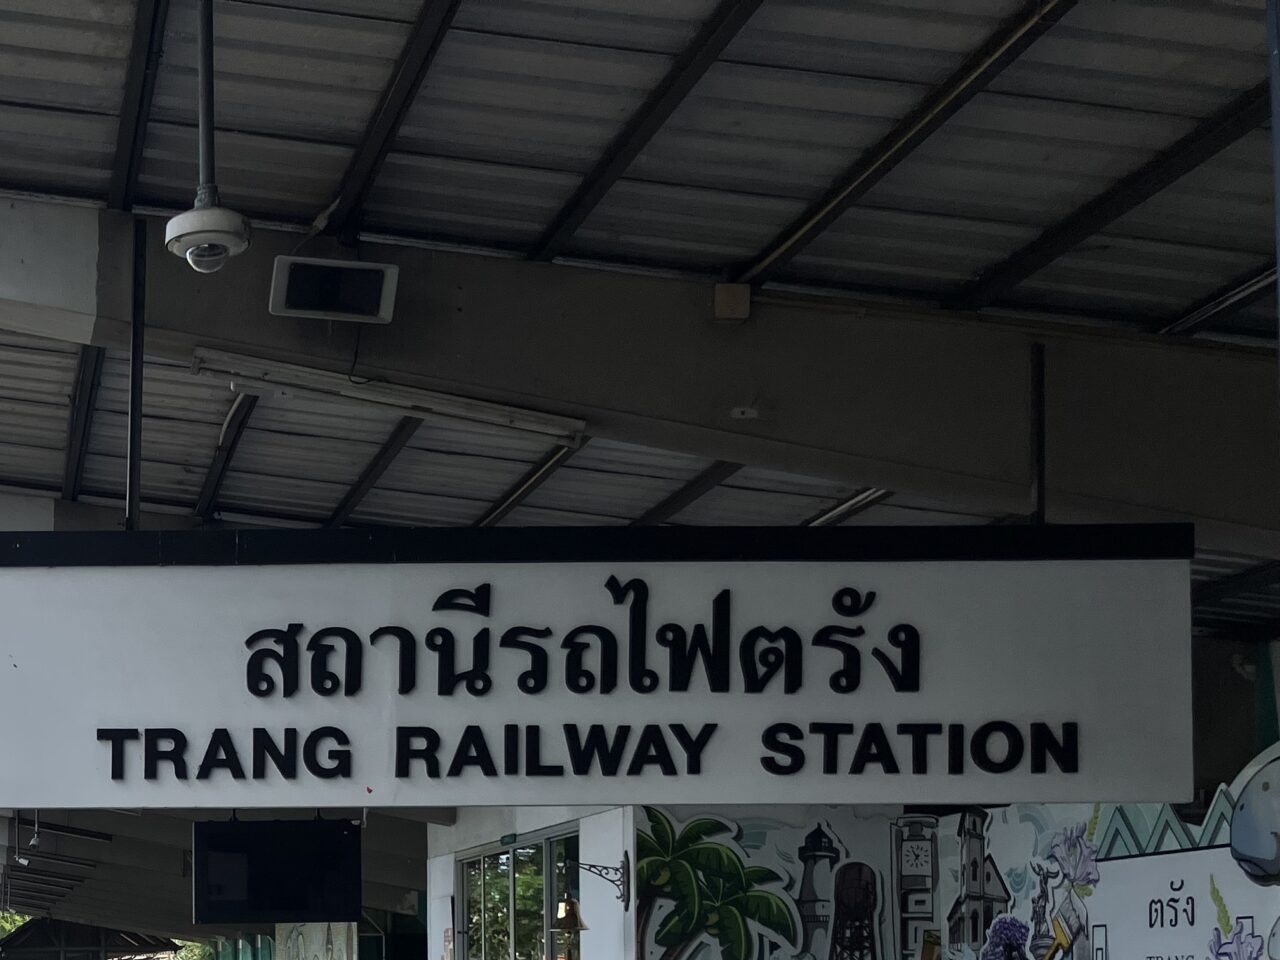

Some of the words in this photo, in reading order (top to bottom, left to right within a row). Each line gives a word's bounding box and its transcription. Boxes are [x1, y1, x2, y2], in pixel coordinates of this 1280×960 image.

[245, 574, 921, 699] สถานีรถไฟตรัง
[96, 726, 352, 781] TRANG
[395, 723, 718, 779] RAILWAY
[760, 721, 1079, 776] STATION
[1148, 879, 1196, 929] ตรัง
